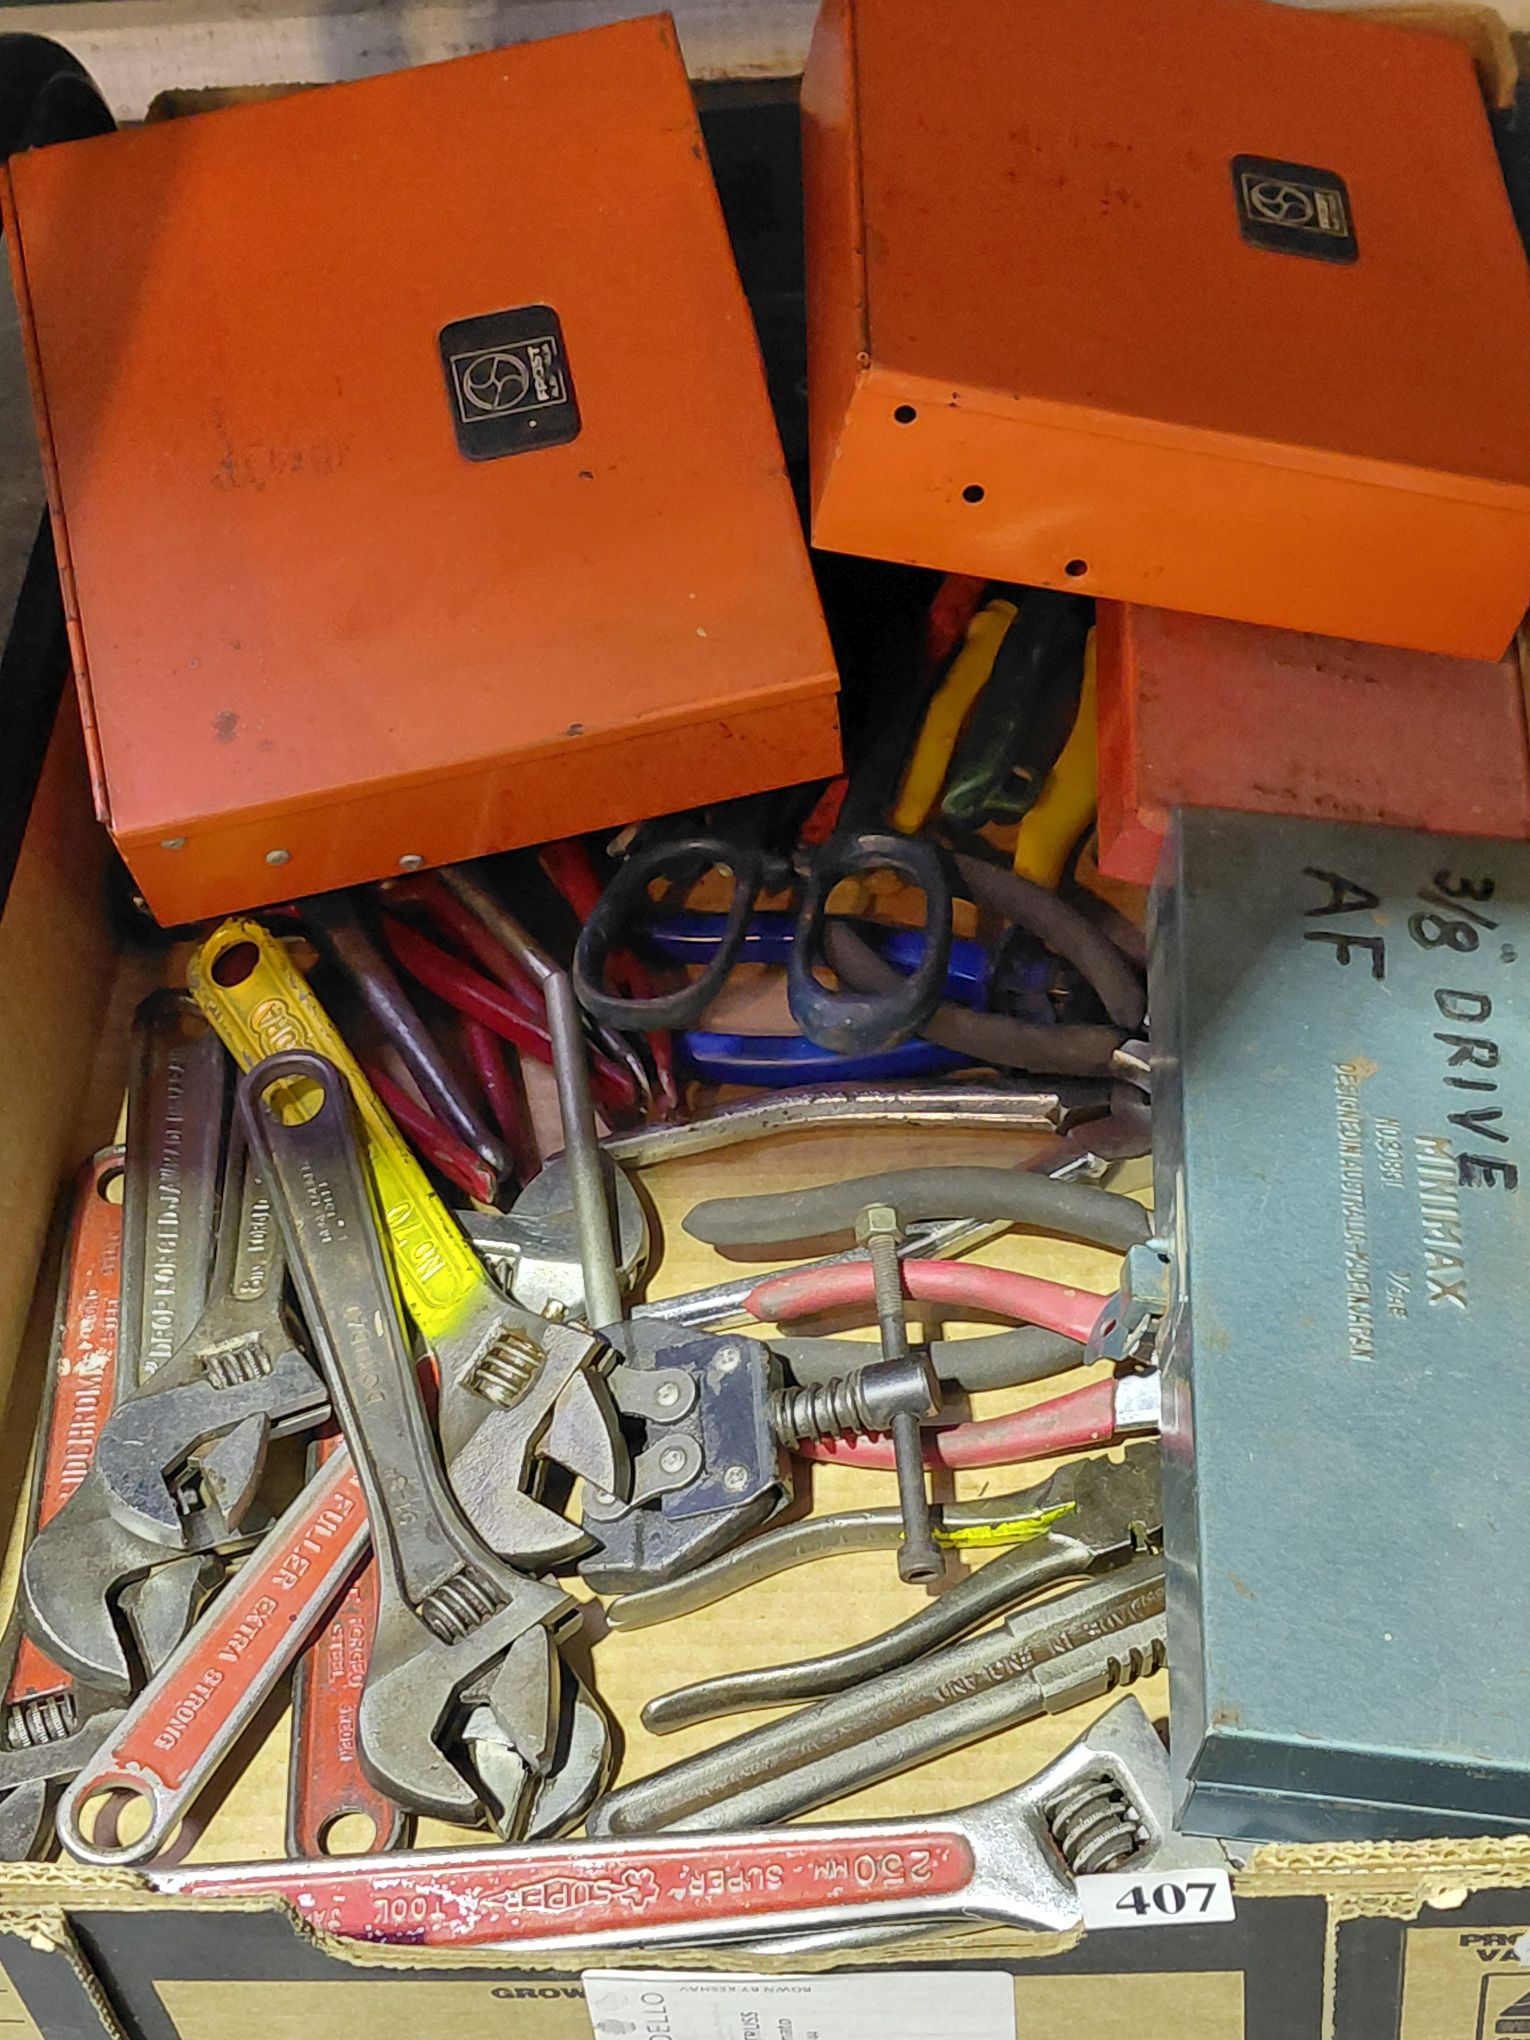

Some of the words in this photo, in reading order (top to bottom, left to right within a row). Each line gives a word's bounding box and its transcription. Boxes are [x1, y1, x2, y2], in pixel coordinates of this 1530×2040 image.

[1303, 867, 1386, 981] AF
[1433, 988, 1519, 1191] DRIVE
[1414, 1135, 1468, 1310] MINIMAX
[271, 1493, 354, 1590] FULLER
[217, 1595, 277, 1663] EXTRA
[153, 1667, 224, 1751] STRONG
[374, 1897, 445, 1922] TOOL
[1116, 1881, 1217, 1916] 407
